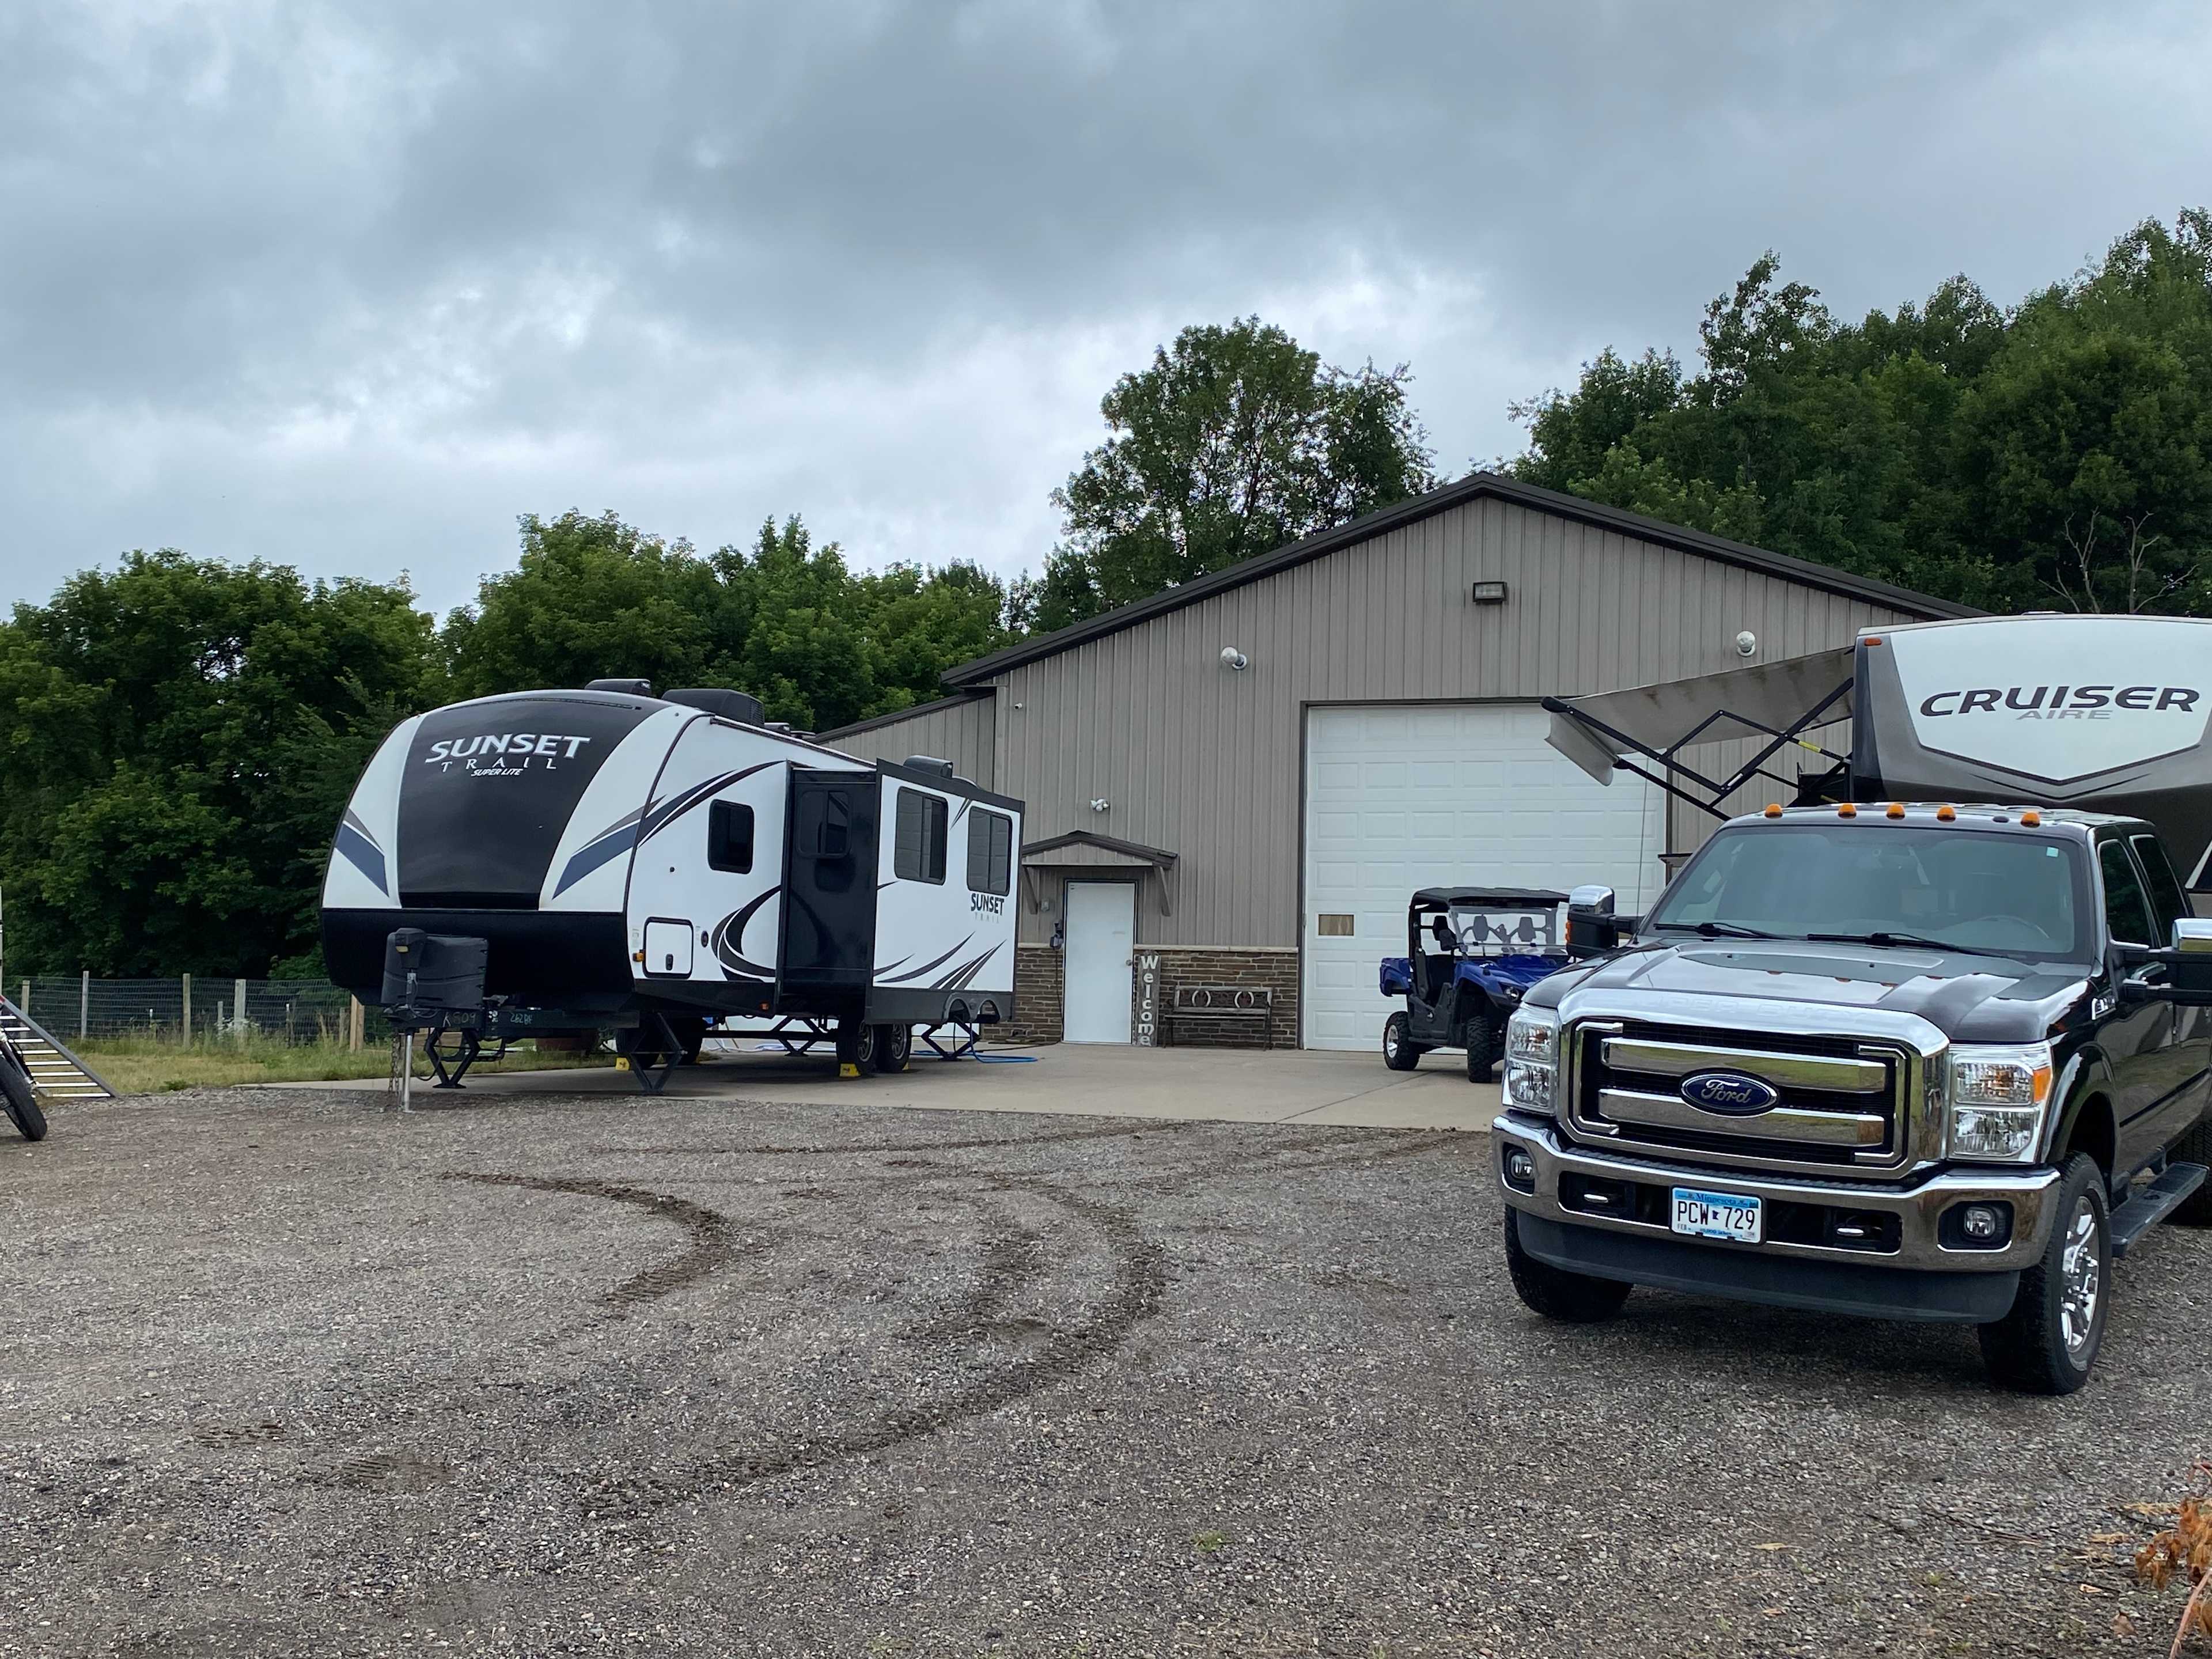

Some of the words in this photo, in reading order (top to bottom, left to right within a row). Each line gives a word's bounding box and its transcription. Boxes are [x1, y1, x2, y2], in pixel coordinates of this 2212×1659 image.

[1920, 685, 2200, 717] CRUISER
[2016, 709, 2113, 720] AIRE
[425, 733, 592, 763] SUNSET
[441, 757, 557, 772] TRAIL
[471, 768, 503, 777] SUPER
[971, 893, 1005, 916] SUNSET
[1138, 955, 1159, 1047] Welcome
[1701, 1080, 1752, 1103] Ford
[1696, 1193, 1736, 1205] Minnesota
[1678, 1201, 1709, 1225] PCW
[1723, 1206, 1755, 1230] 729
